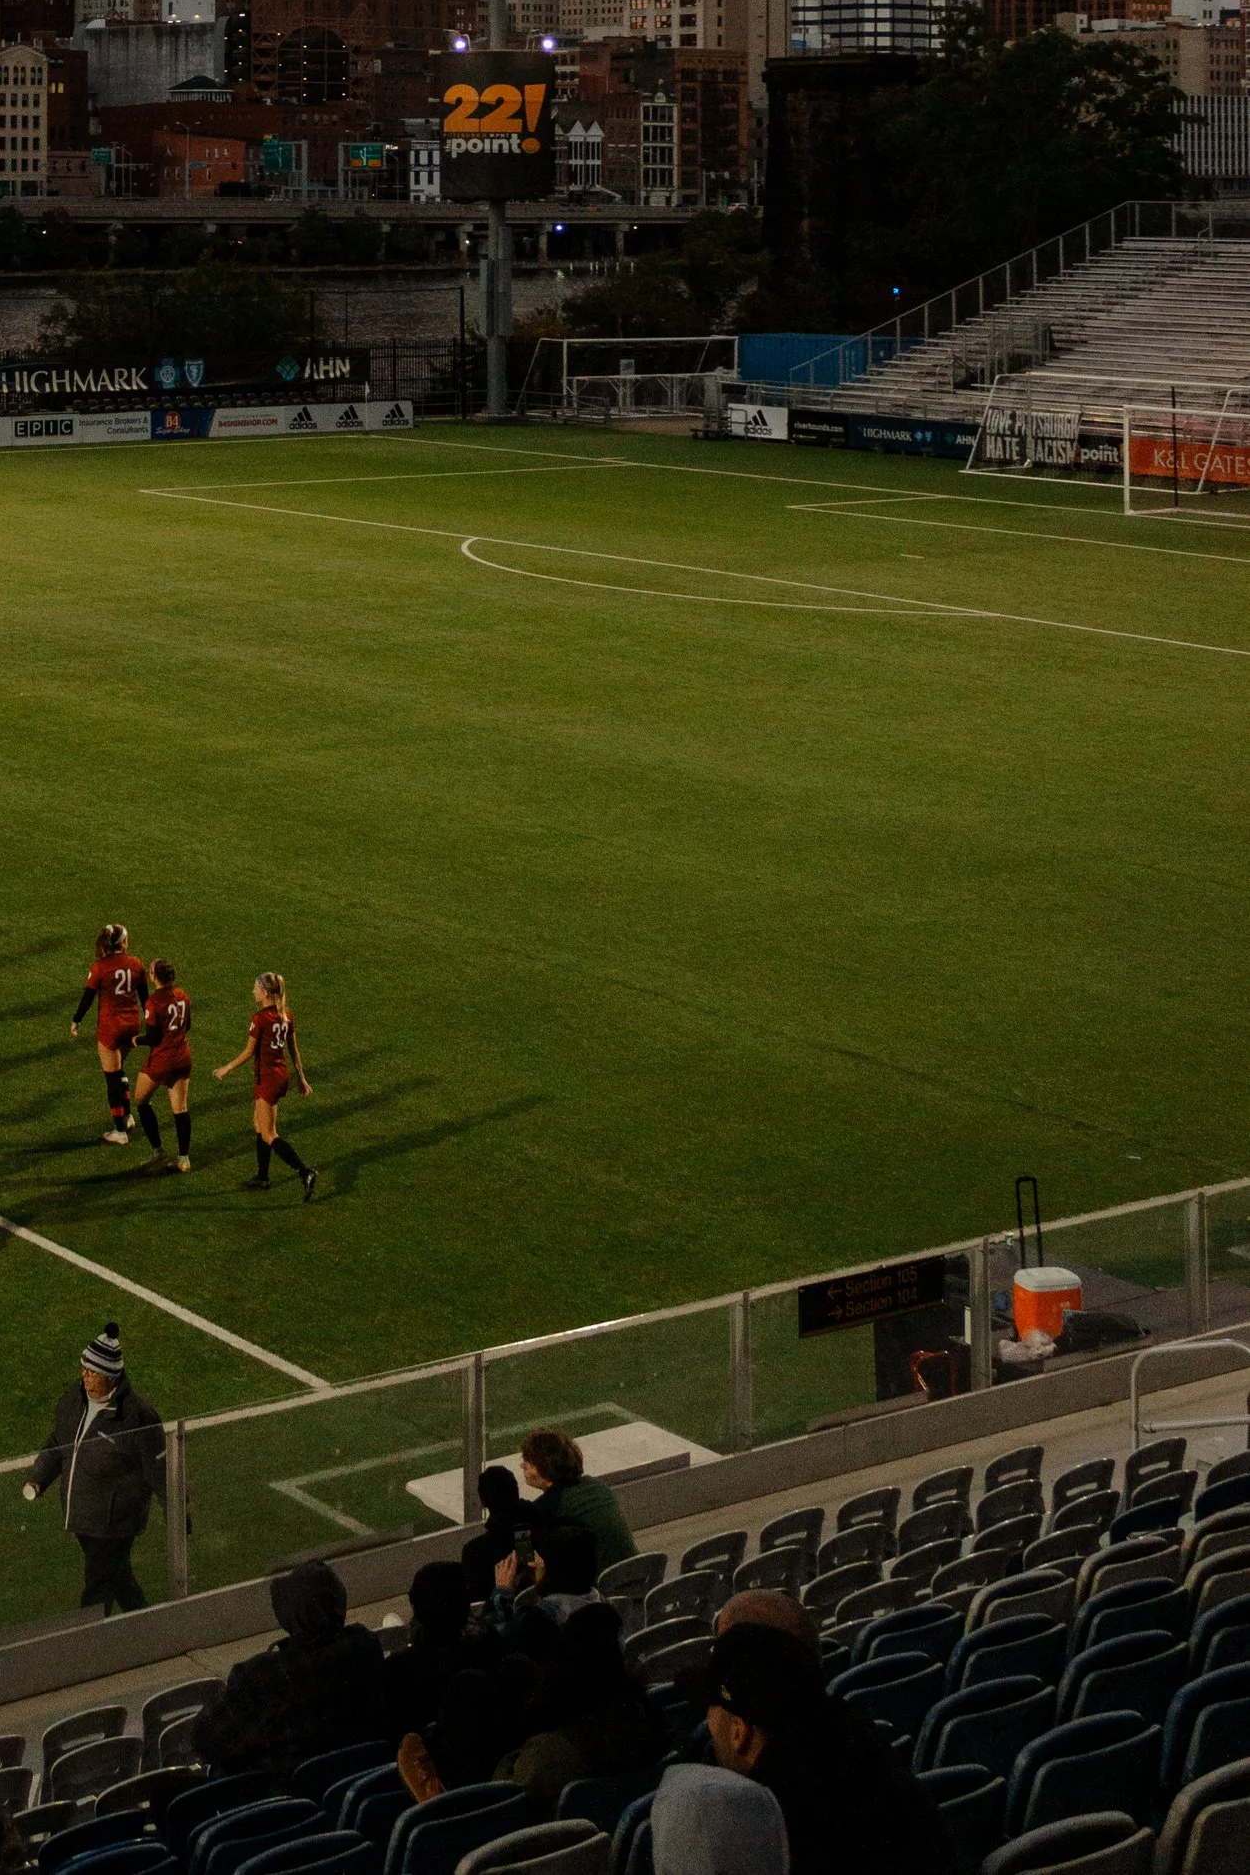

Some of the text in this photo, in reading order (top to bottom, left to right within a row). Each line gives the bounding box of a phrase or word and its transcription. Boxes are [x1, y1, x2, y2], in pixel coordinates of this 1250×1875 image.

[452, 133, 521, 159] point
[1, 367, 148, 393] HIGHMARK
[15, 420, 73, 436] EPIC
[107, 426, 148, 435] Consultants
[115, 417, 142, 425] Brokers
[289, 421, 317, 429] adidas
[336, 419, 364, 428] adidas
[382, 418, 409, 426] adidas
[986, 409, 1012, 435] LOVE
[744, 426, 772, 436] adidas
[863, 427, 912, 442] HIGHMARK
[986, 435, 1020, 460] HATE
[1080, 448, 1119, 463] point
[1153, 447, 1190, 470] K&L
[115, 968, 132, 995] 21
[167, 1000, 186, 1031] 27
[845, 1265, 918, 1297] Section 105
[846, 1286, 918, 1317] Section 104
